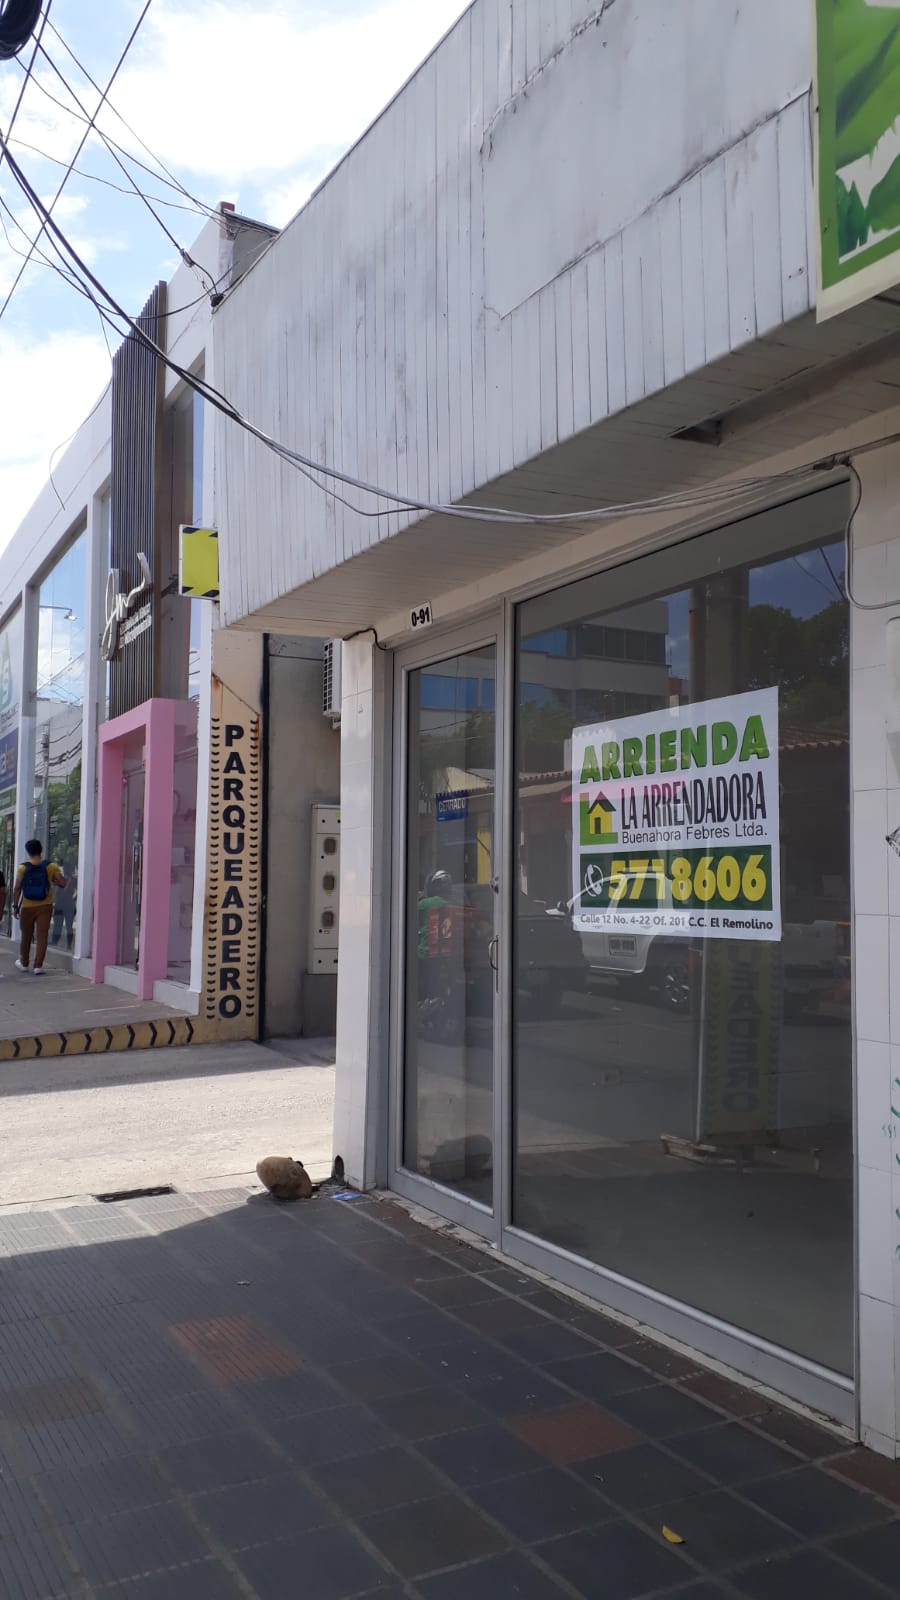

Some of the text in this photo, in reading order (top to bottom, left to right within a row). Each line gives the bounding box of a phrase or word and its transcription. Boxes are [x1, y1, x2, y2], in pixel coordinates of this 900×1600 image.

[411, 606, 430, 627] 0-91
[580, 714, 770, 784] ARRIENDA
[621, 771, 767, 830] LA ARRENDADORA
[622, 822, 768, 844] Buenahora Febres Ltda.
[218, 724, 246, 1019] PARQUEADERO
[580, 914, 773, 930] Calle 12 No. 4-22 Of. 201 C.C. El Remolino
